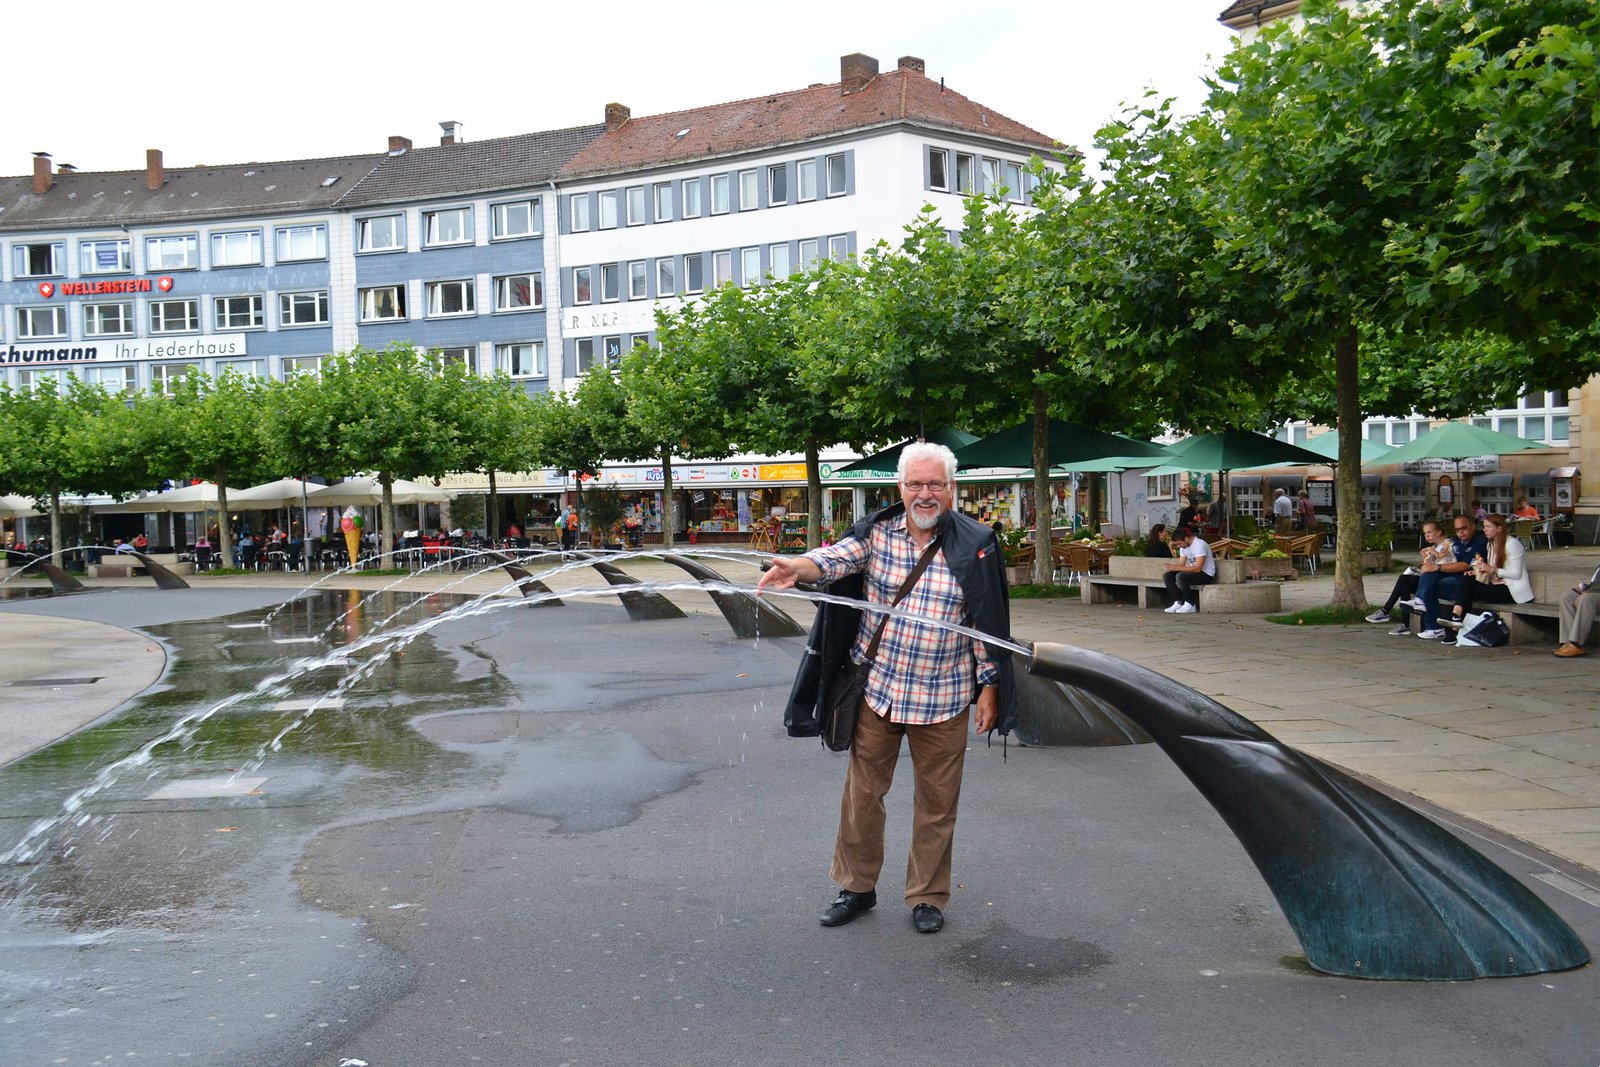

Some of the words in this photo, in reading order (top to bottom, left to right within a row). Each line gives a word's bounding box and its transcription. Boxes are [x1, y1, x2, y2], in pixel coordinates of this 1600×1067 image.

[61, 279, 151, 295] WELLENSTEYN
[115, 343, 139, 358] Ihr
[147, 339, 236, 357] Lederhaus
[445, 477, 474, 485] BISTRO
